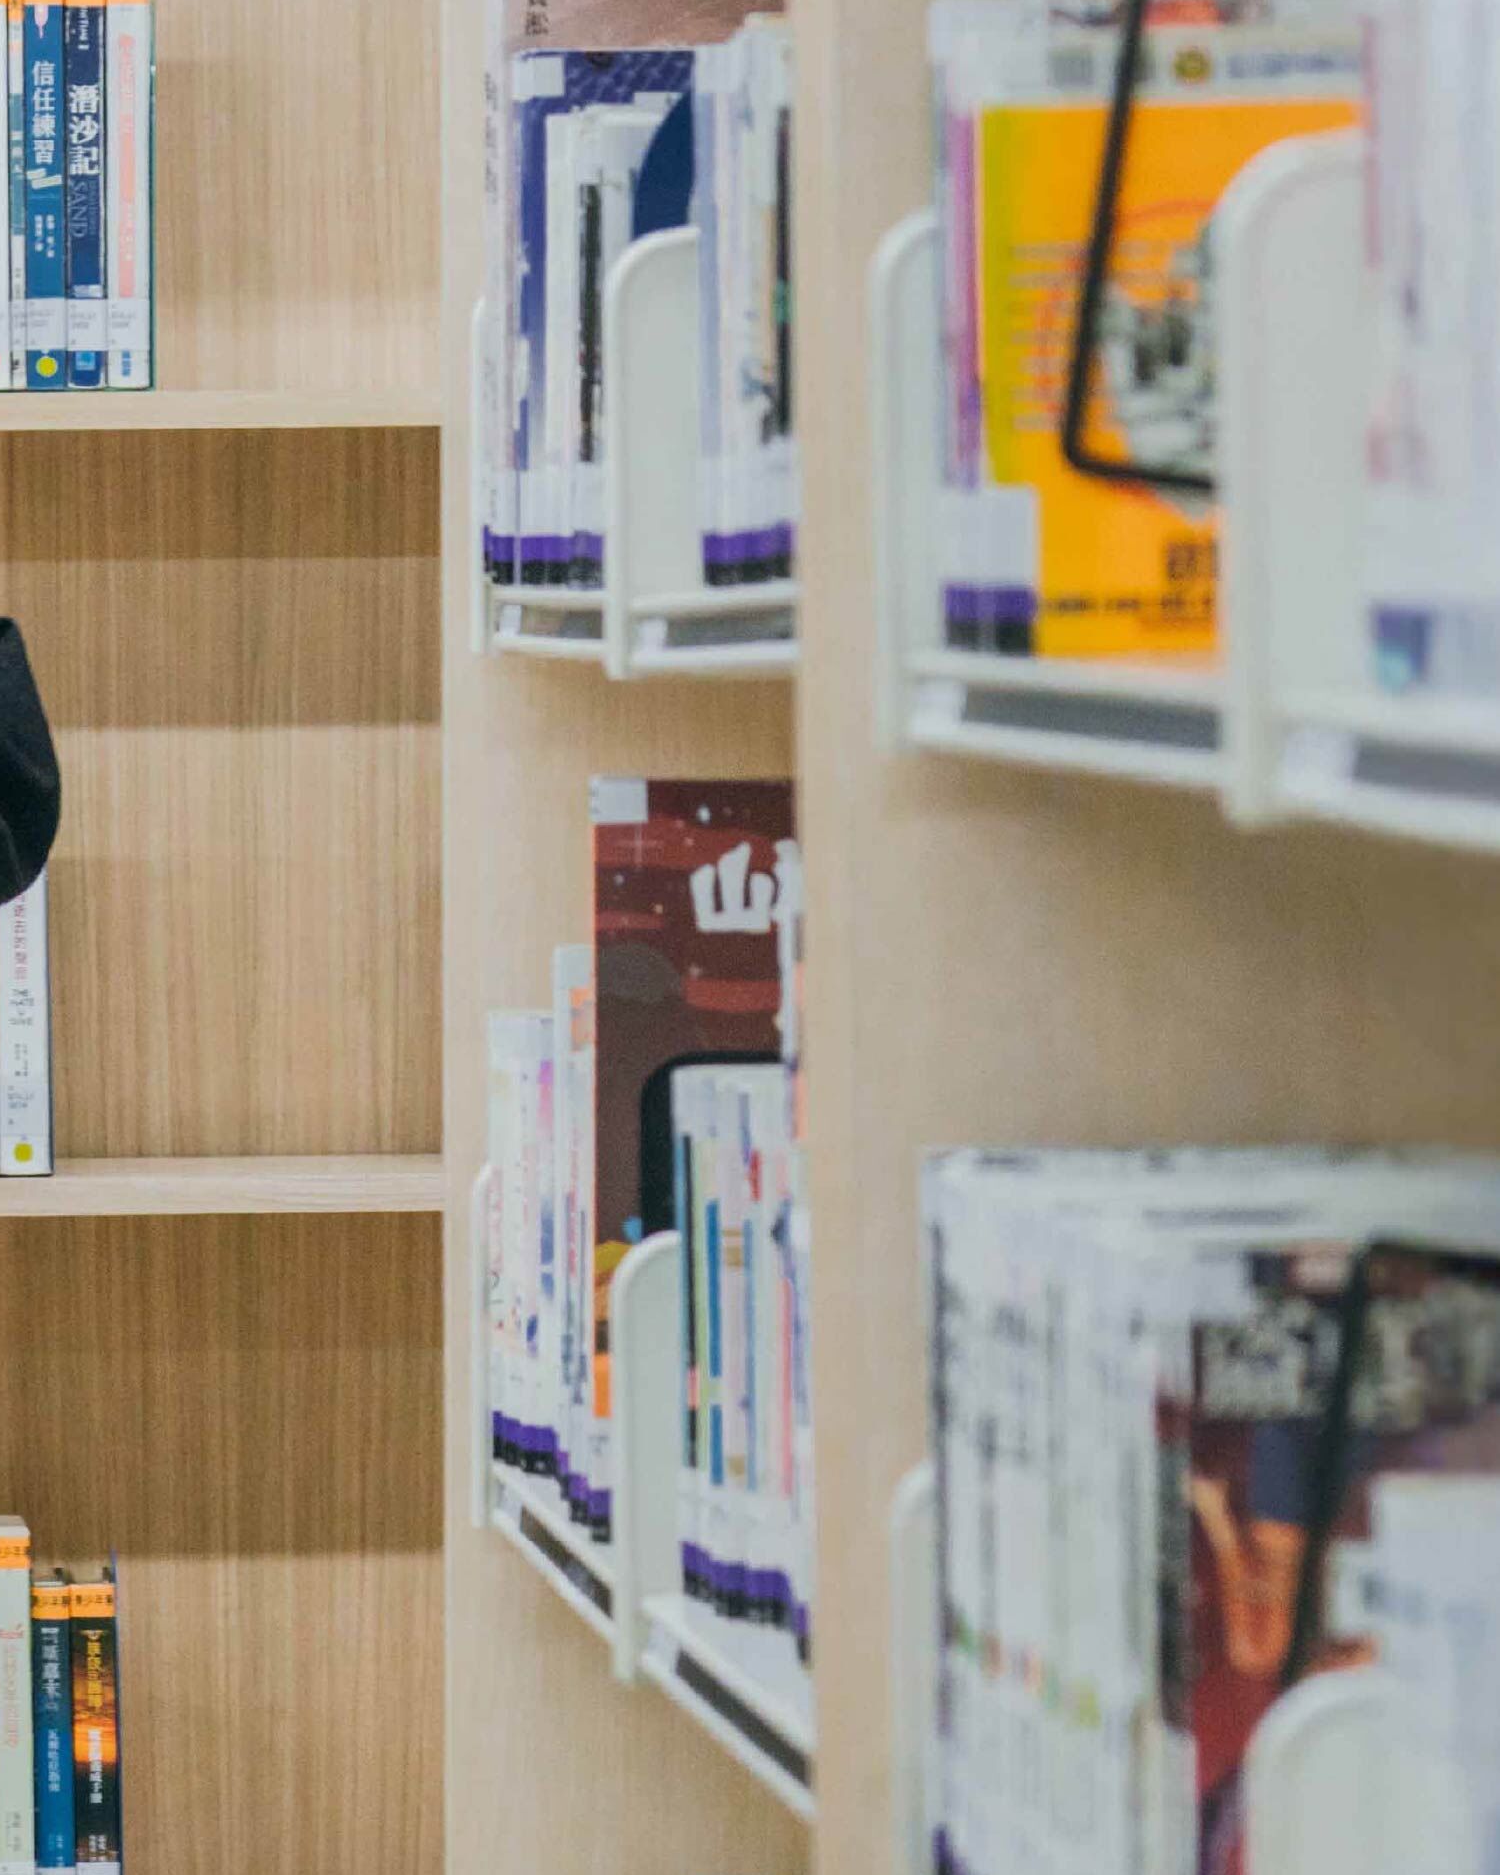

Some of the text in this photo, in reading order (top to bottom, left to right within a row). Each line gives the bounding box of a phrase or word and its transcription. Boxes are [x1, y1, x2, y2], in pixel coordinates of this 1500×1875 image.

[30, 58, 57, 166] 信任練習
[67, 82, 102, 177] 潛沙記
[69, 179, 91, 239] SAND
